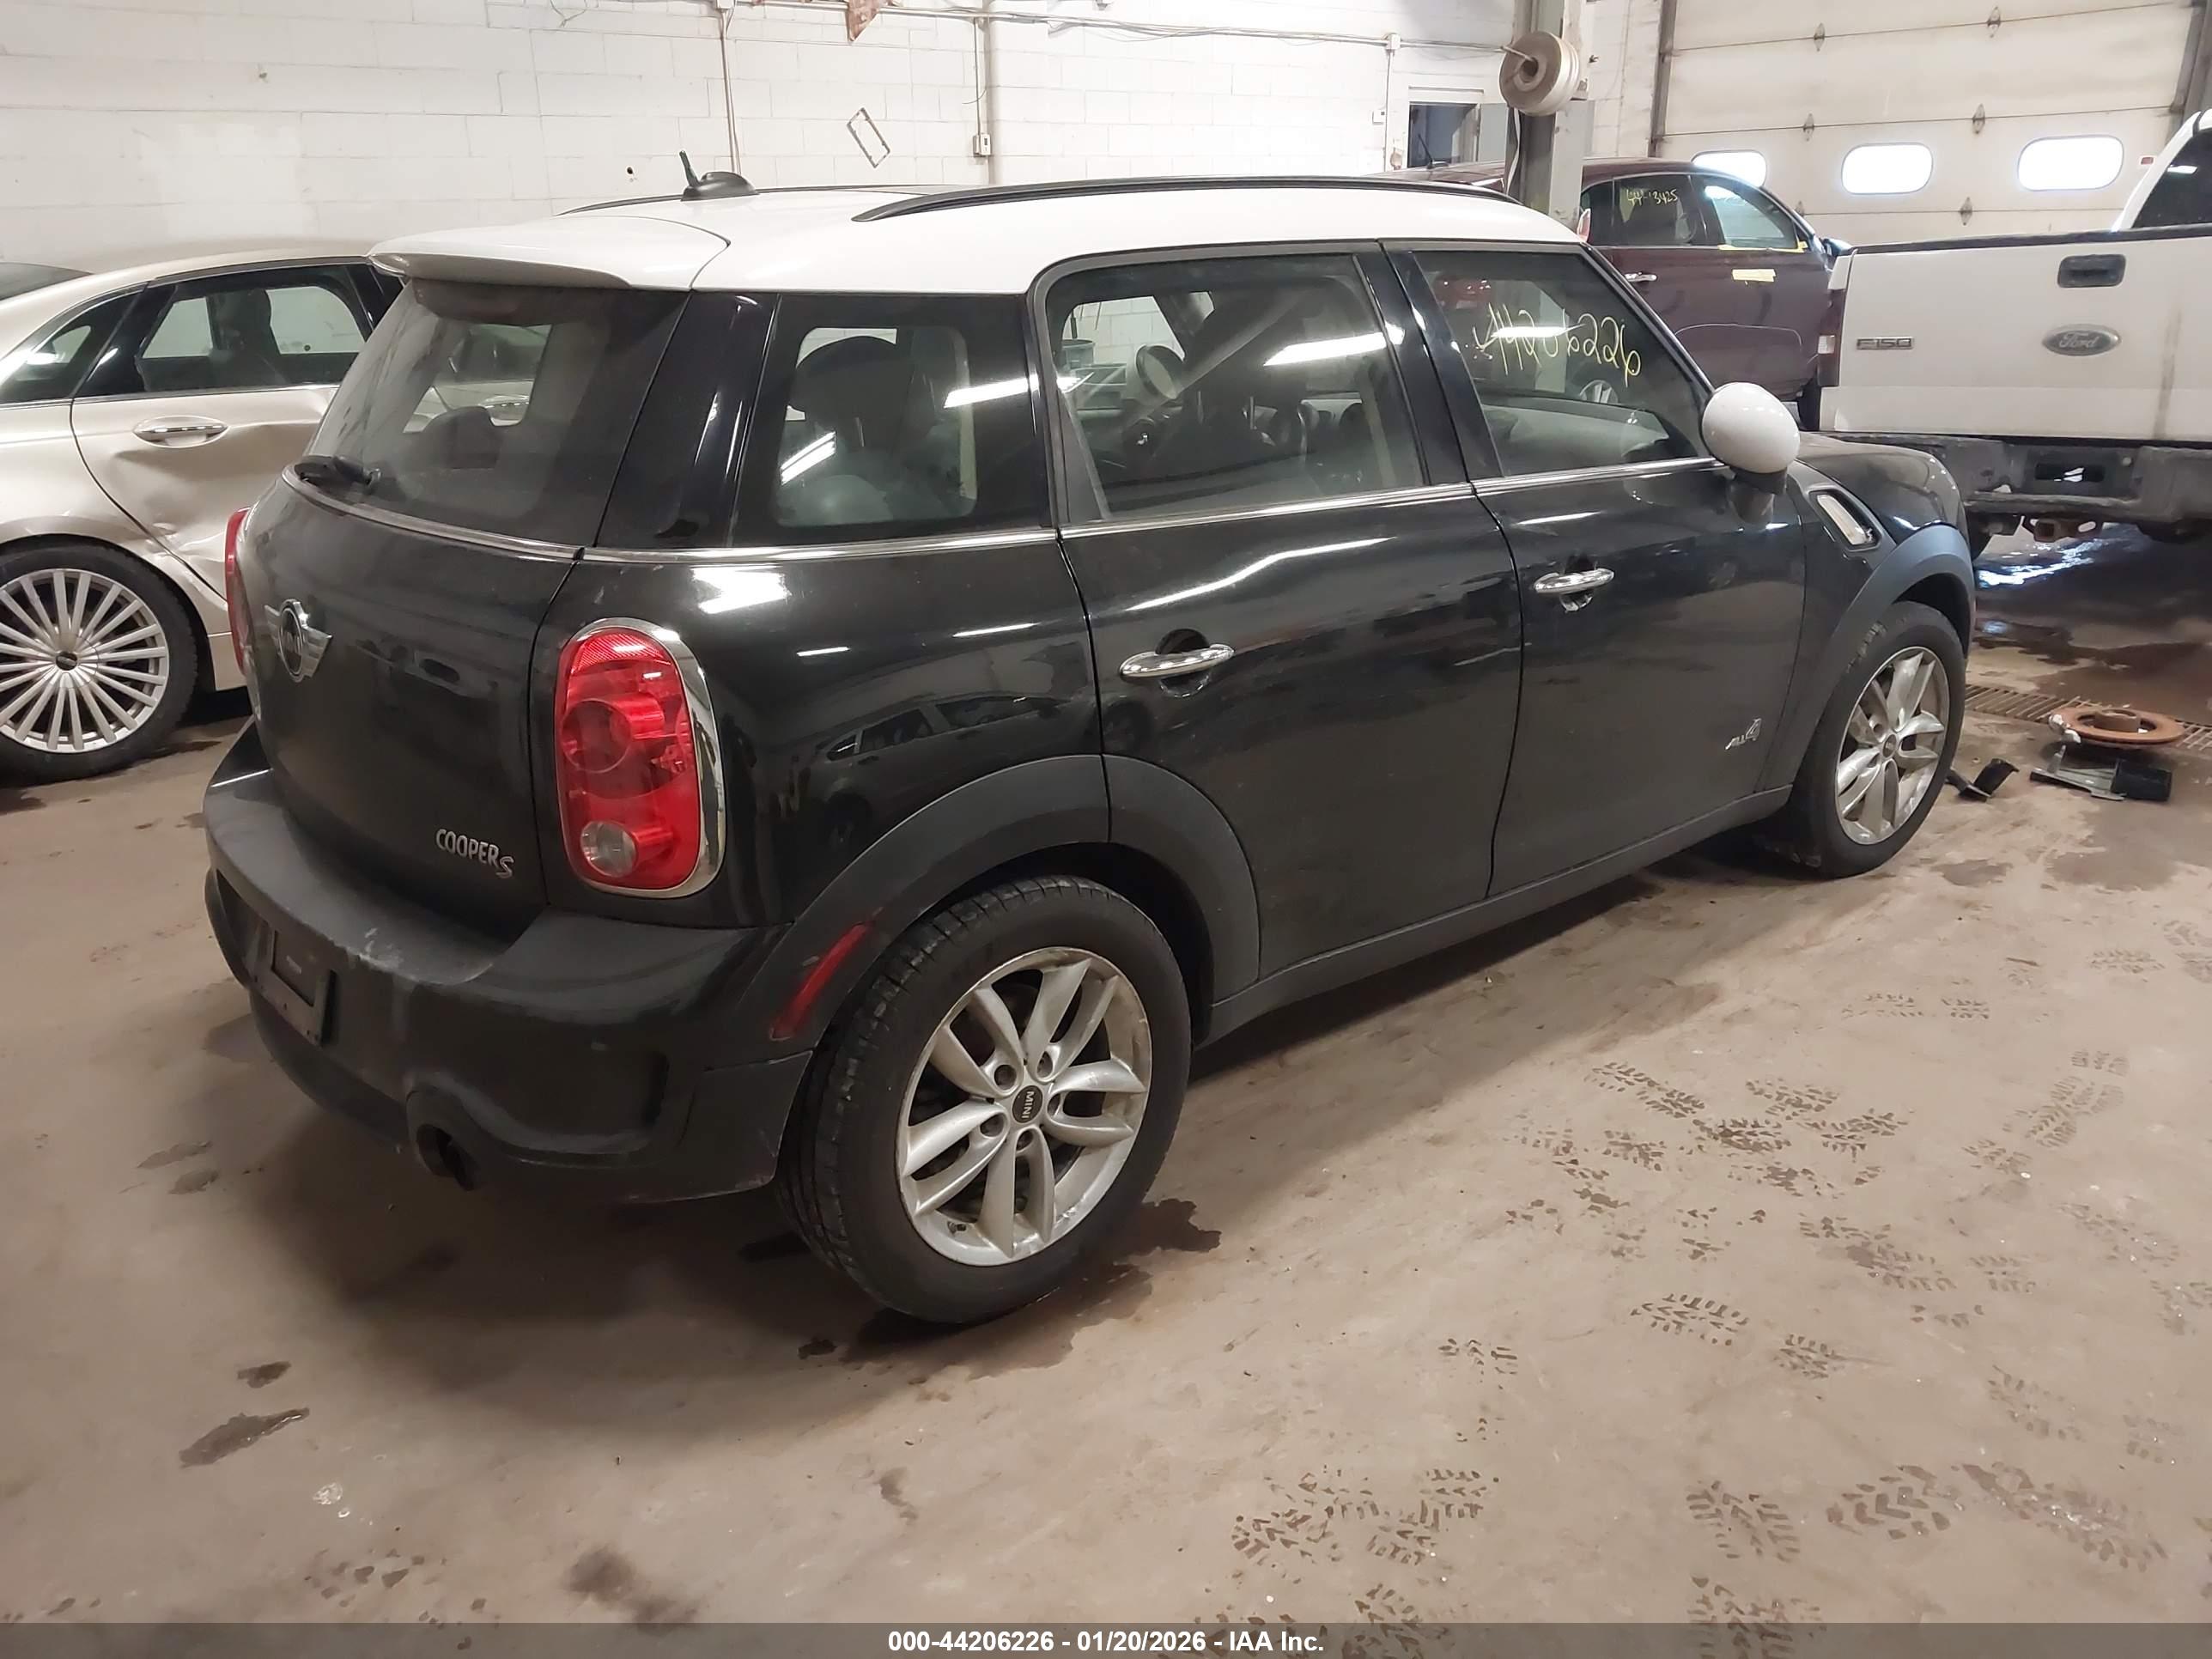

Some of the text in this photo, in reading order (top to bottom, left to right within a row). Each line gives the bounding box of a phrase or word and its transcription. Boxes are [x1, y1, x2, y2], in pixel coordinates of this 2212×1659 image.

[436, 828, 514, 879] COOPER S
[1021, 1091, 1035, 1119] MINI
